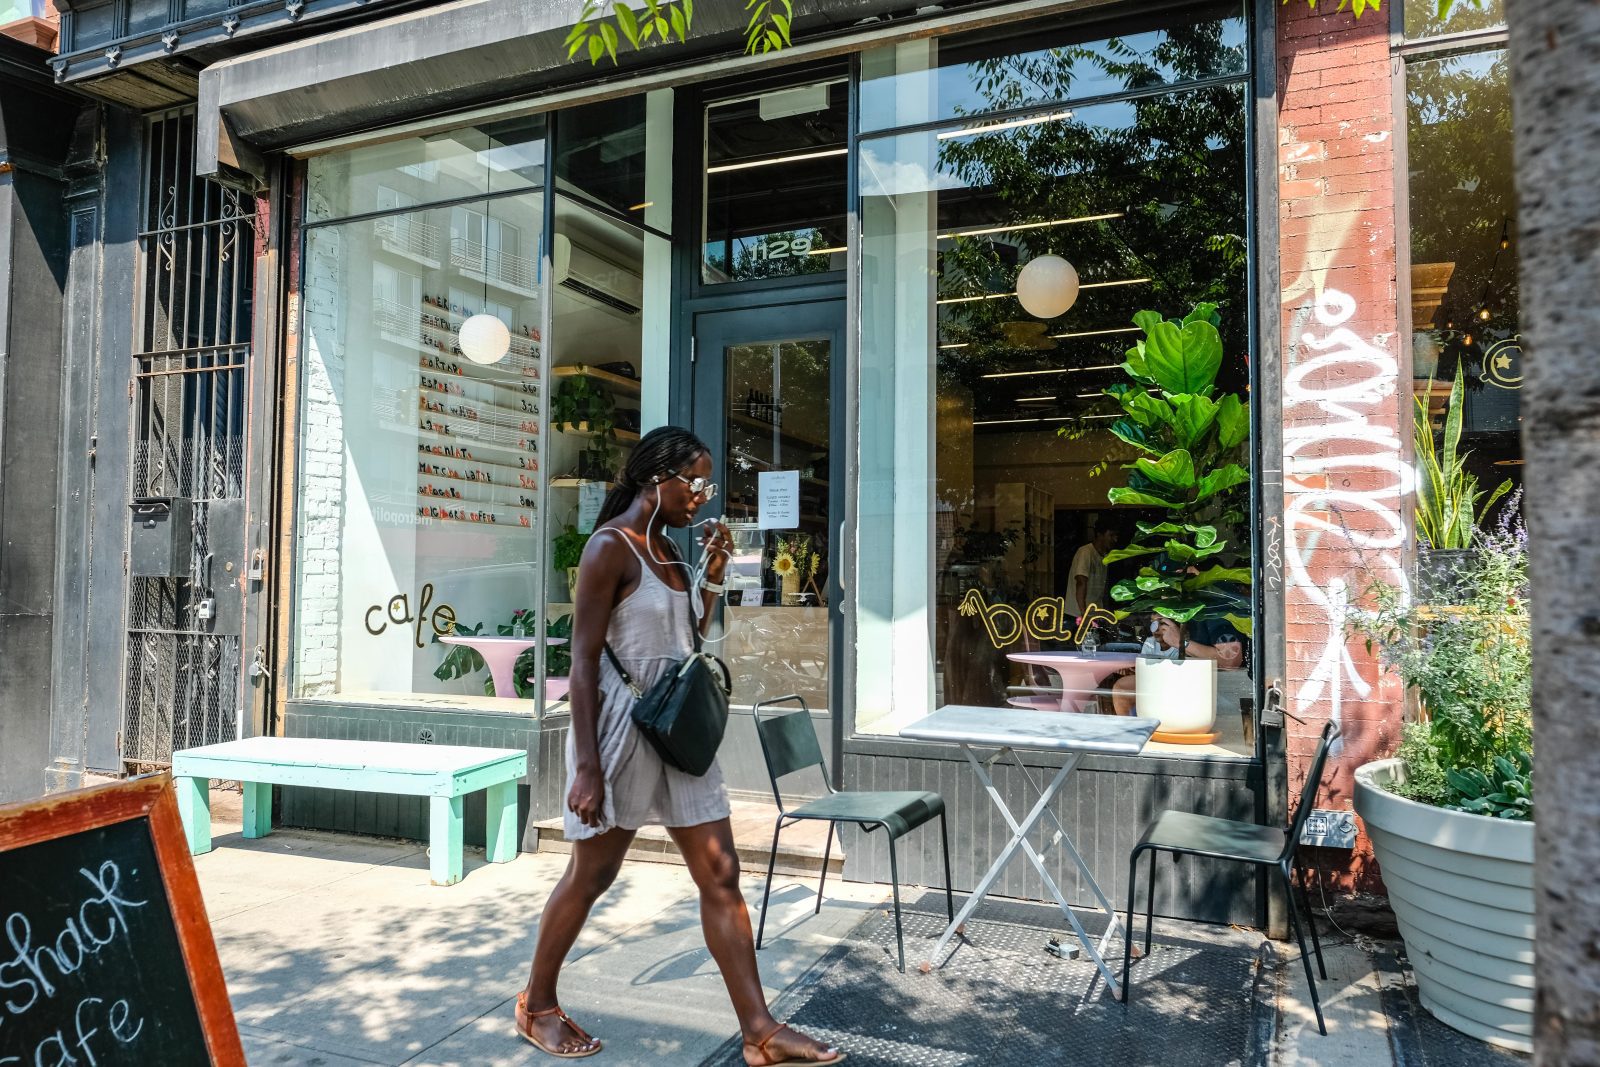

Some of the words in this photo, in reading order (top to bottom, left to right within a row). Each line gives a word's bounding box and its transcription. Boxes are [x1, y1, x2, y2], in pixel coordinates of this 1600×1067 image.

[750, 237, 812, 261] 1129
[365, 583, 455, 648] cafe
[958, 588, 1118, 648] bar
[0, 860, 148, 1014] shack
[0, 997, 144, 1067] afe
